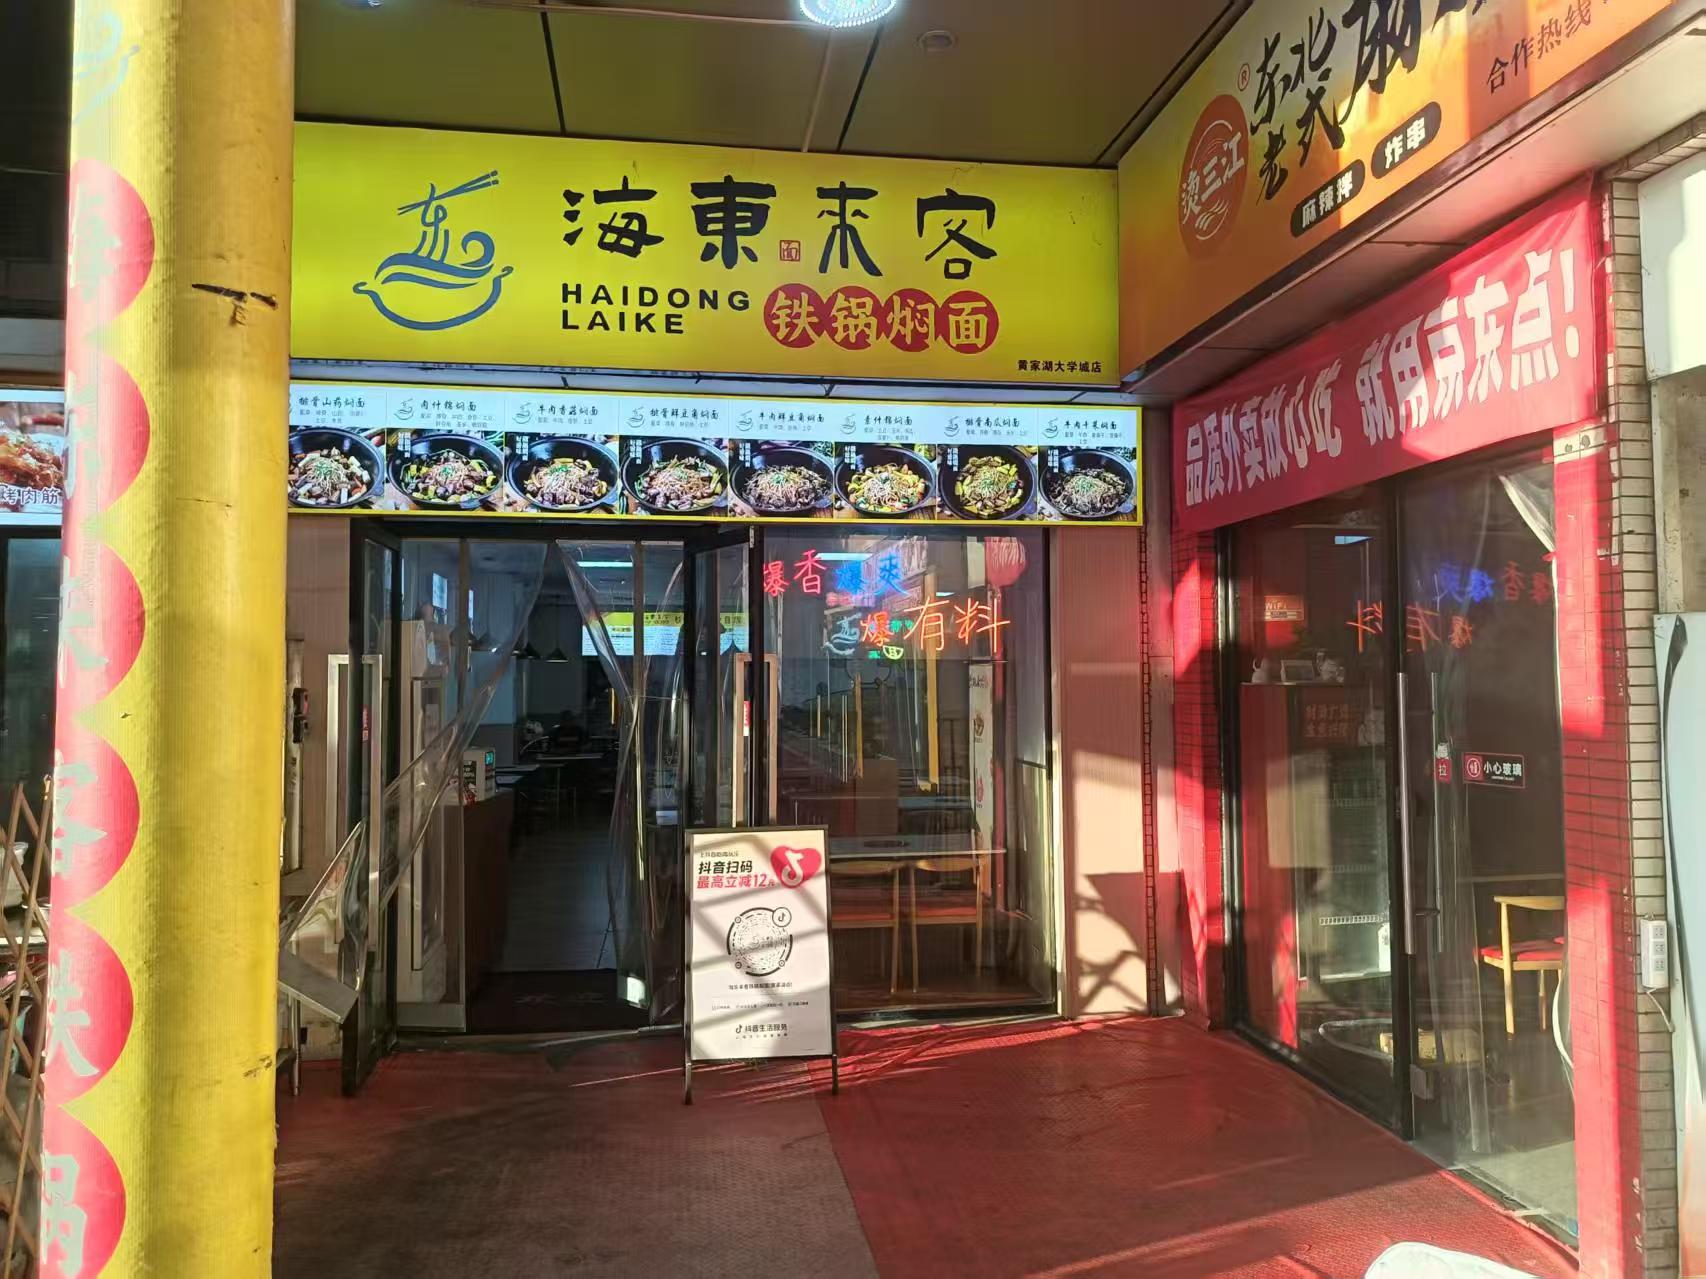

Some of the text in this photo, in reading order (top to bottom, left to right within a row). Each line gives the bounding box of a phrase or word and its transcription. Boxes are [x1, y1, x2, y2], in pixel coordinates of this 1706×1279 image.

[1486, 0, 1592, 95] 合作热线
[1384, 117, 1426, 169] 炸串
[1302, 170, 1353, 228] 麻辣拌
[562, 283, 750, 311] HAIDONG
[562, 310, 684, 334] LAIKE
[770, 290, 989, 349] 铁锅焖面
[1017, 359, 1102, 374] 黄家湖大学城店
[1186, 248, 1581, 507] 品质外卖放心吃 就用京东点!
[763, 549, 826, 597] 爆香
[1484, 761, 1522, 776] 小心玻璃
[696, 873, 777, 889] 最高立减12元
[698, 860, 753, 875] 抖音扫码
